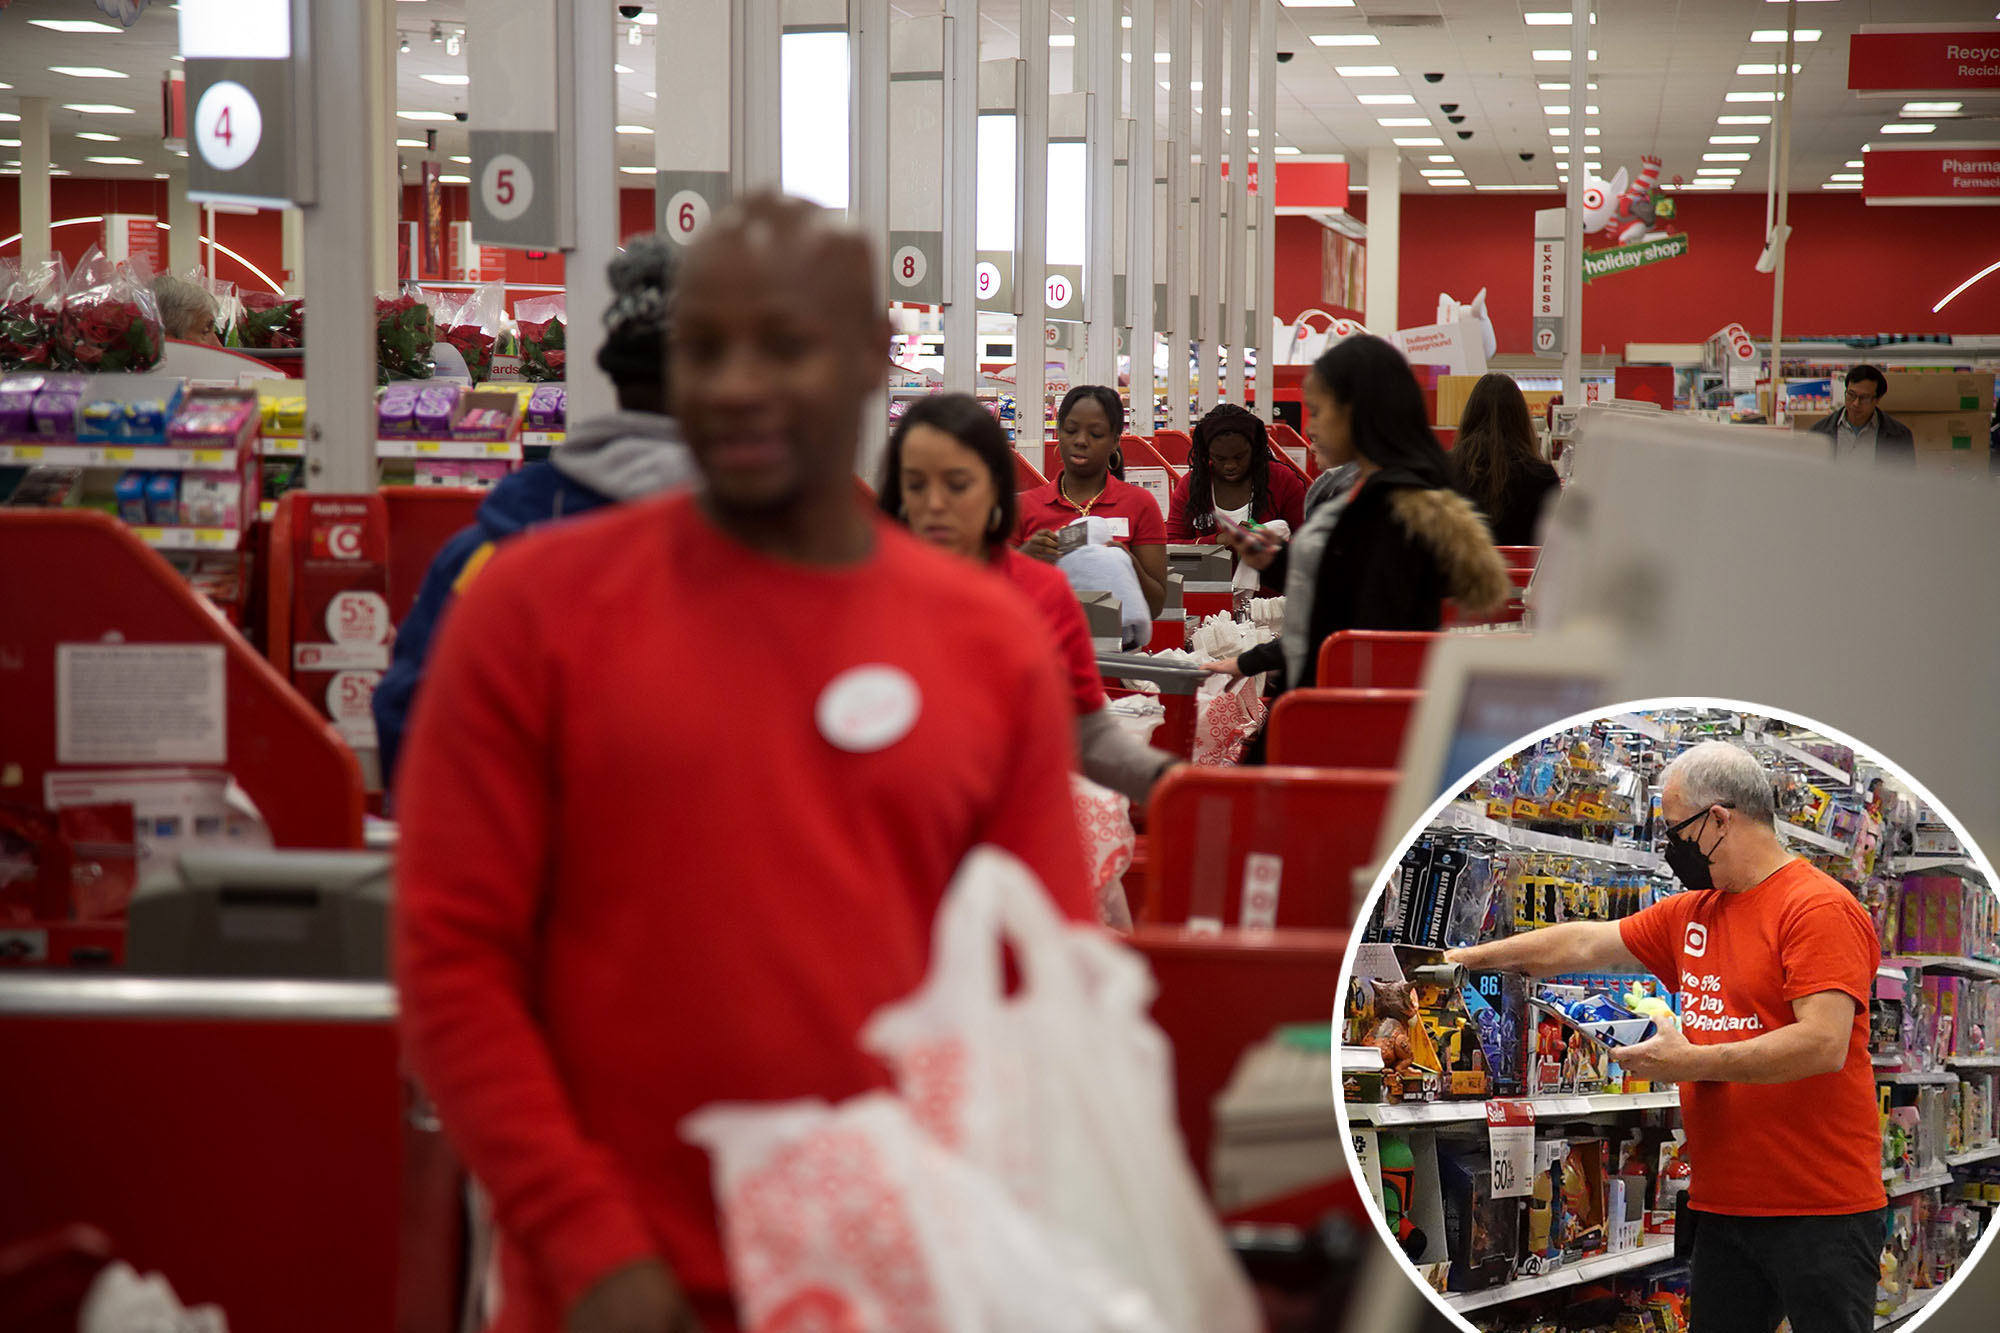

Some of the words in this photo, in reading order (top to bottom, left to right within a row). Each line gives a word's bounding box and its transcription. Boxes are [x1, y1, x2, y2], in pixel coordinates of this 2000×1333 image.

[1946, 45, 2000, 62] Recyc
[214, 105, 234, 148] 4
[1942, 159, 2000, 173] Pharma
[496, 169, 515, 205] 5
[679, 202, 695, 233] 6
[902, 256, 915, 278] 8
[1584, 250, 1641, 275] holiday
[1644, 241, 1681, 261] shop
[979, 272, 990, 291] 9
[1048, 284, 1065, 301] 10
[1542, 244, 1552, 313] EXPRESS
[1540, 333, 1552, 345] 17
[1401, 867, 1415, 903] BATMAN
[1436, 871, 1450, 907] BATMAN
[1429, 906, 1443, 941] HAZMAT
[1700, 974, 1721, 992] 5%
[1700, 994, 1724, 1014] Day
[1494, 1160, 1508, 1190] 50
